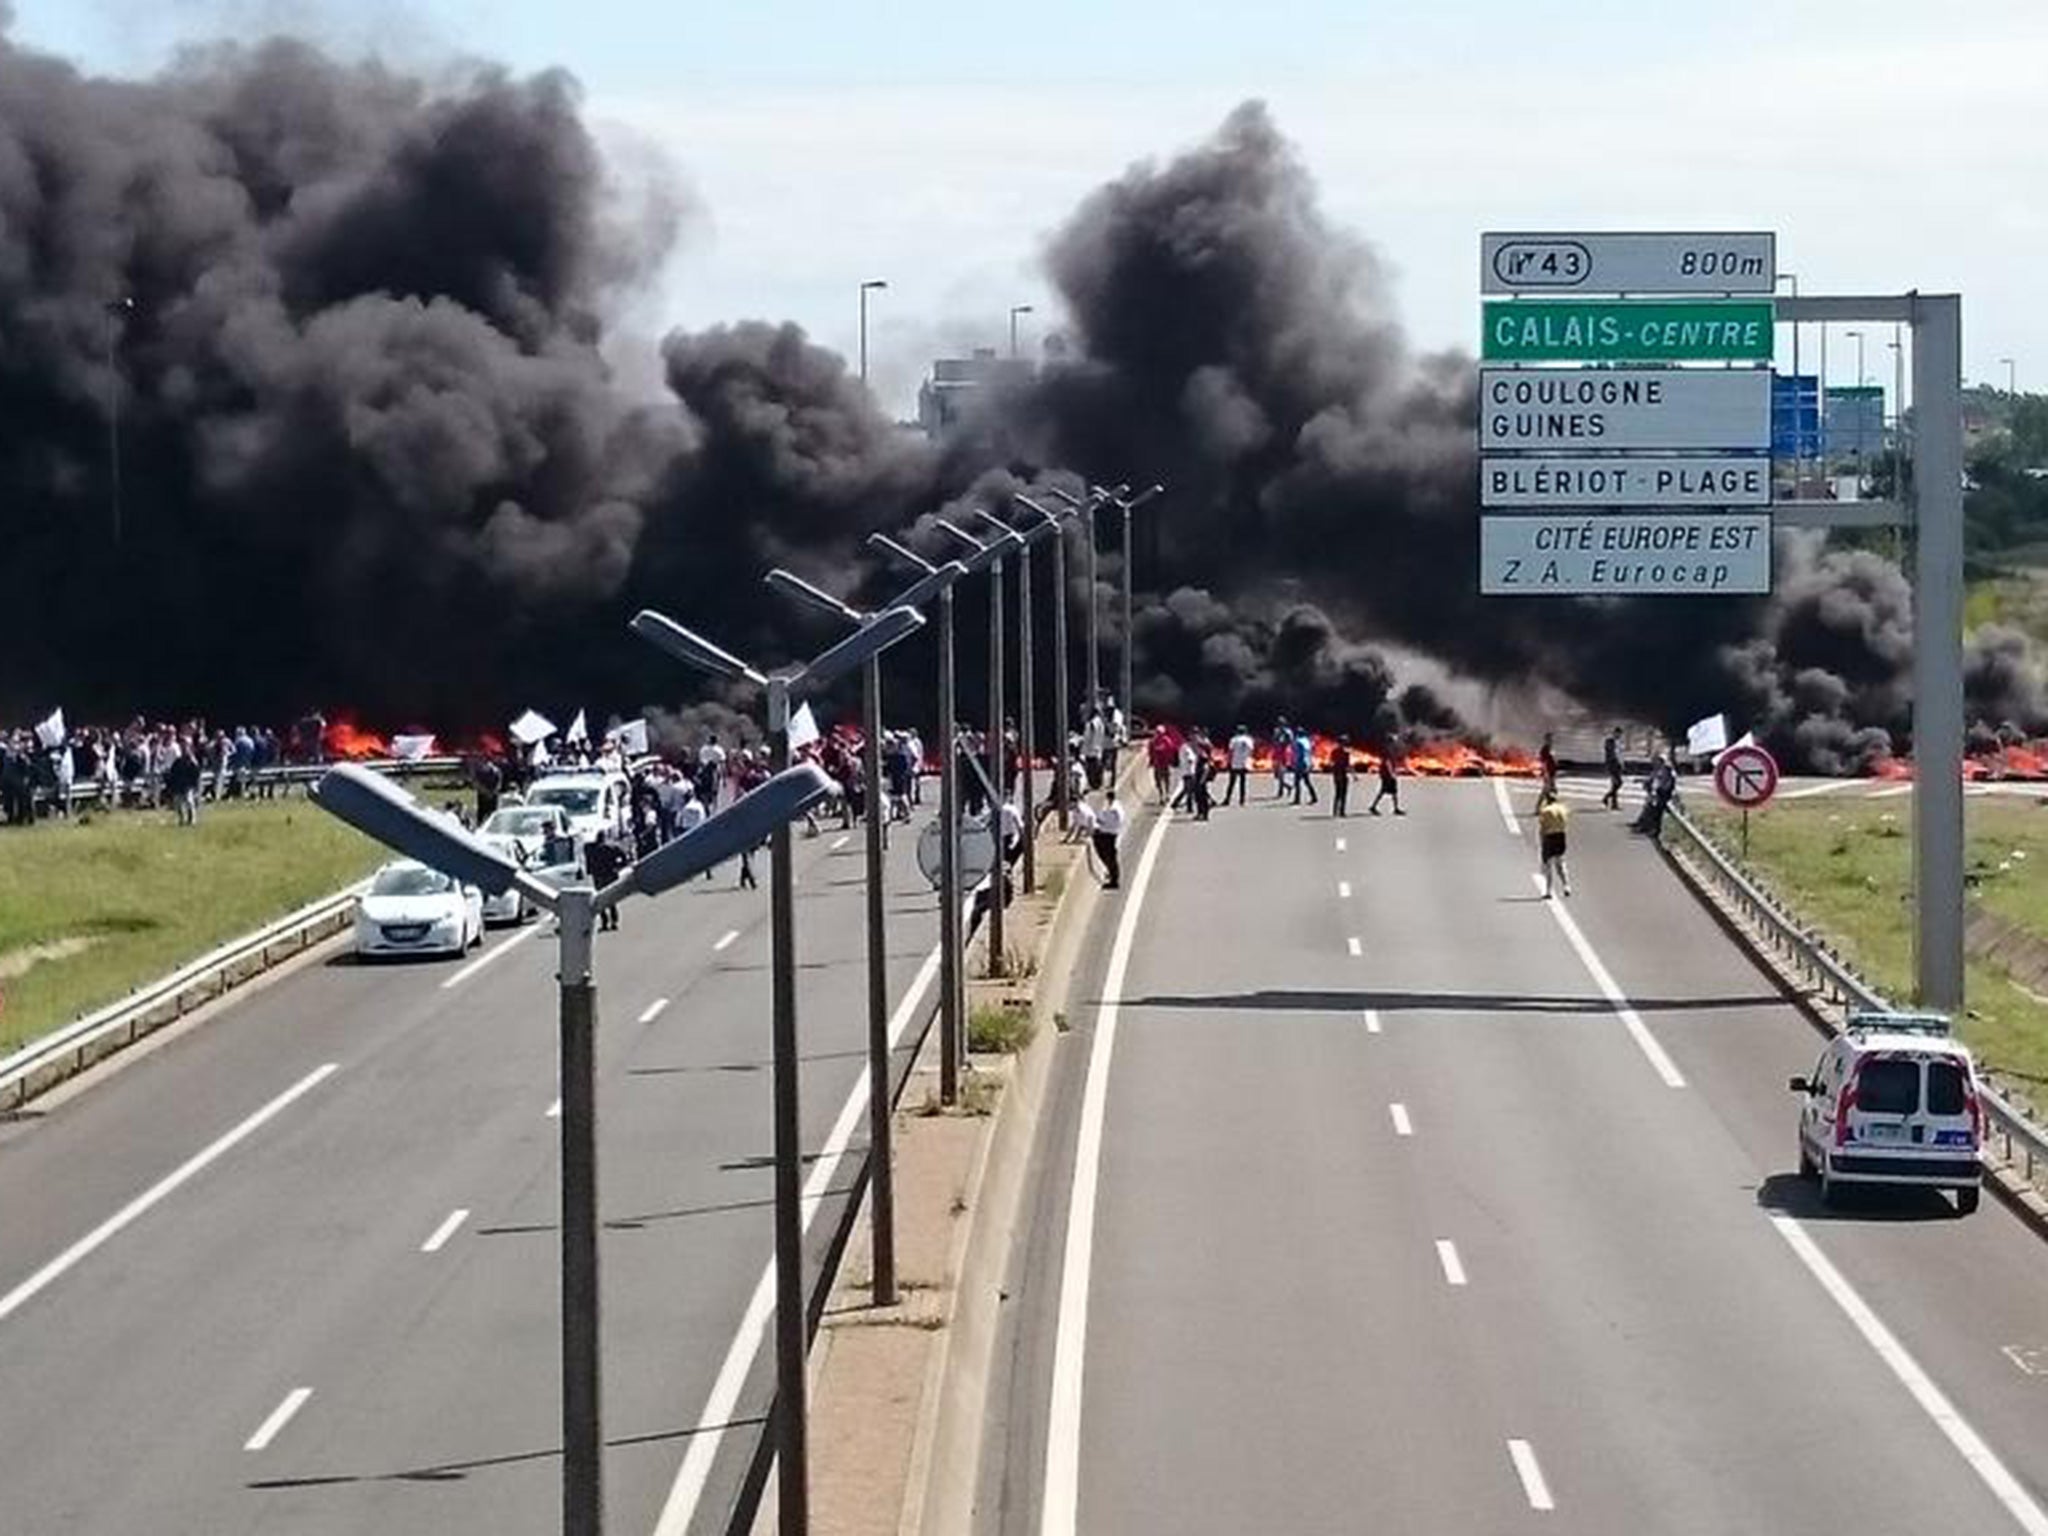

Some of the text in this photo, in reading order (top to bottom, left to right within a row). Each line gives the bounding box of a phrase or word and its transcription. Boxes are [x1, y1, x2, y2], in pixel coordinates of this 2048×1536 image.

[1541, 252, 1581, 275] 43
[1681, 252, 1763, 275] 800m
[1493, 381, 1663, 404] COULOGNE
[1493, 414, 1605, 437] GUINES
[1535, 520, 1760, 550] CITÉ EUROPE EST
[1591, 559, 1728, 588] Eurocap
